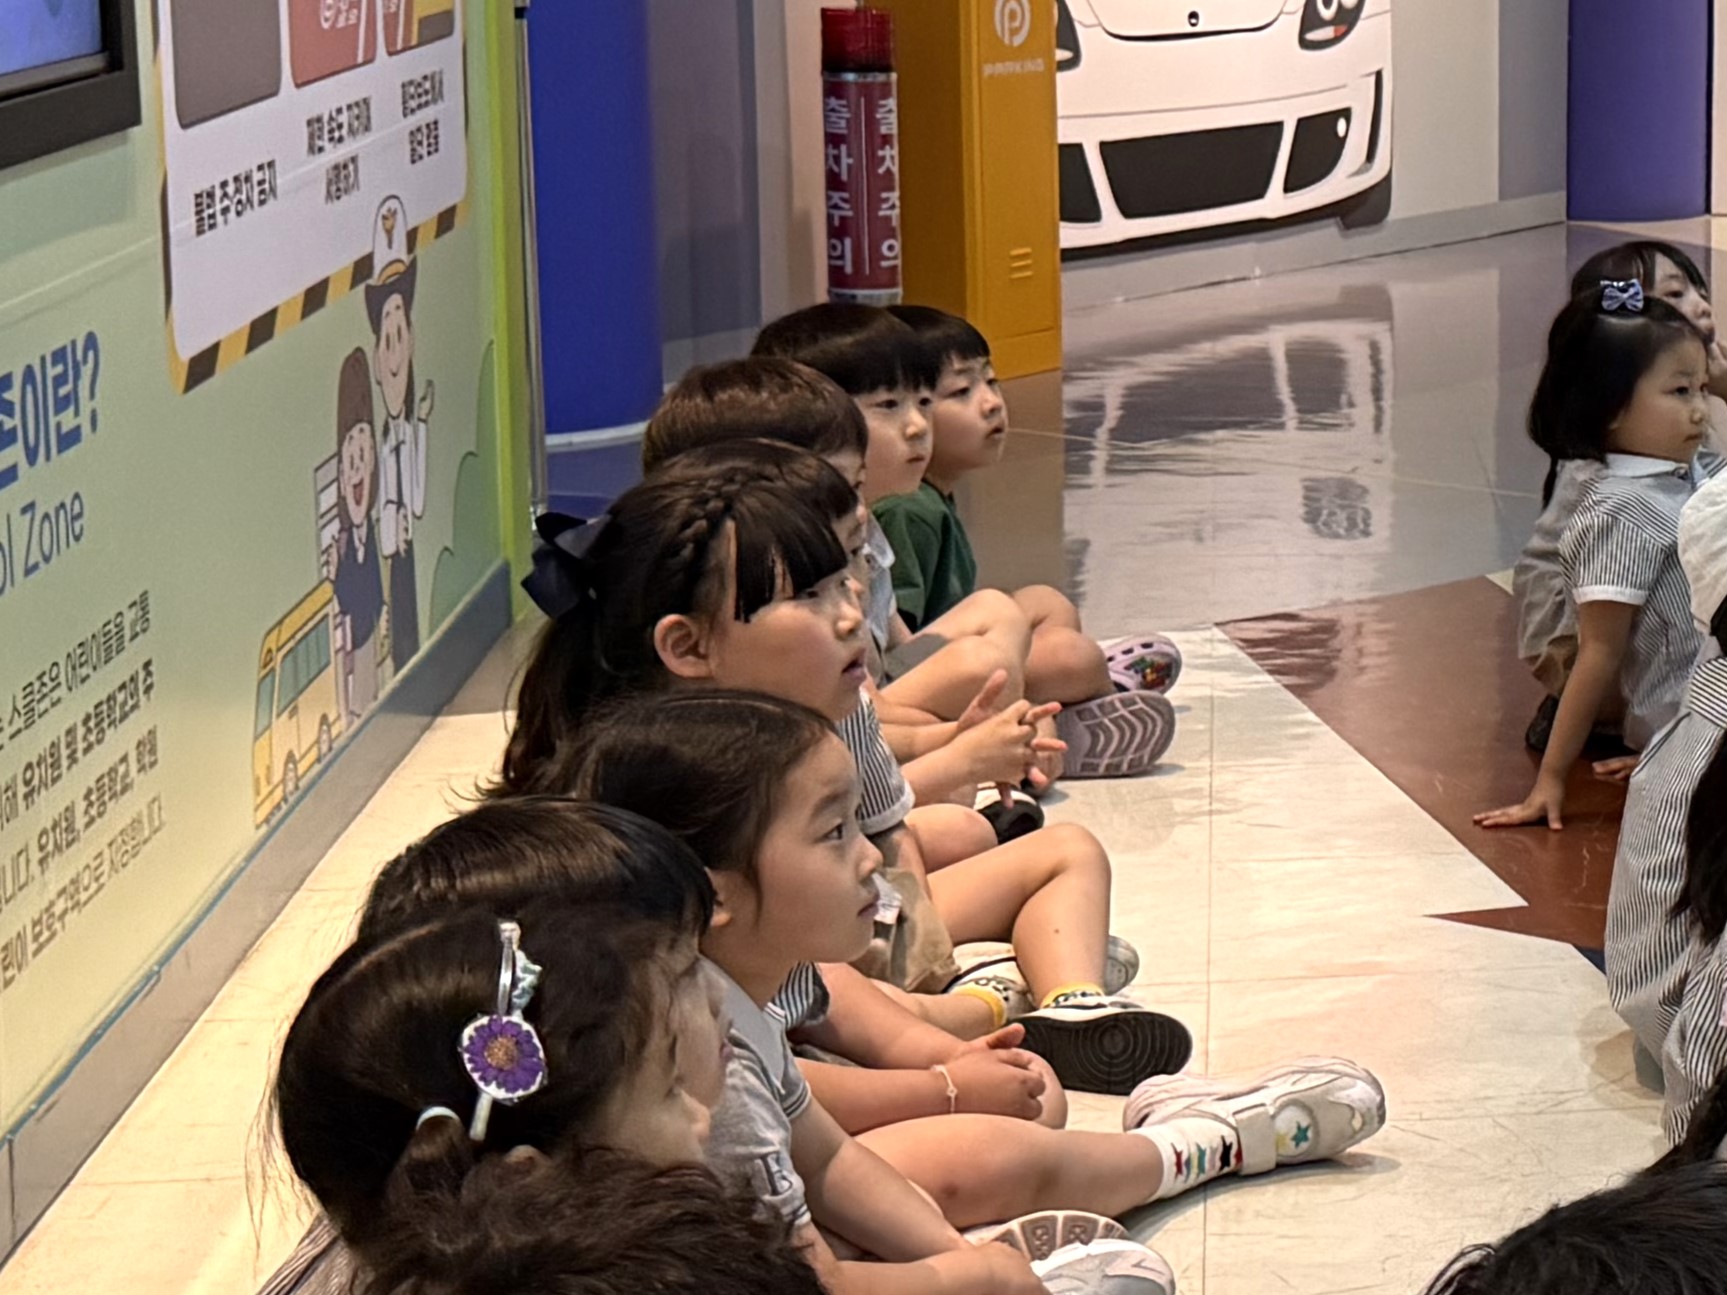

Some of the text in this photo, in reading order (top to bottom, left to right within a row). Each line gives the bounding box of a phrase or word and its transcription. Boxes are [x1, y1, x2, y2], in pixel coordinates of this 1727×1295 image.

[256, 159, 277, 208] 금지
[825, 96, 853, 275] 출차주의
[20, 491, 84, 578] Zone
[8, 661, 62, 741] 스쿨존은
[65, 611, 126, 693] 어린이들을
[128, 590, 151, 643] 교통
[31, 851, 106, 960] 보호구역으로
